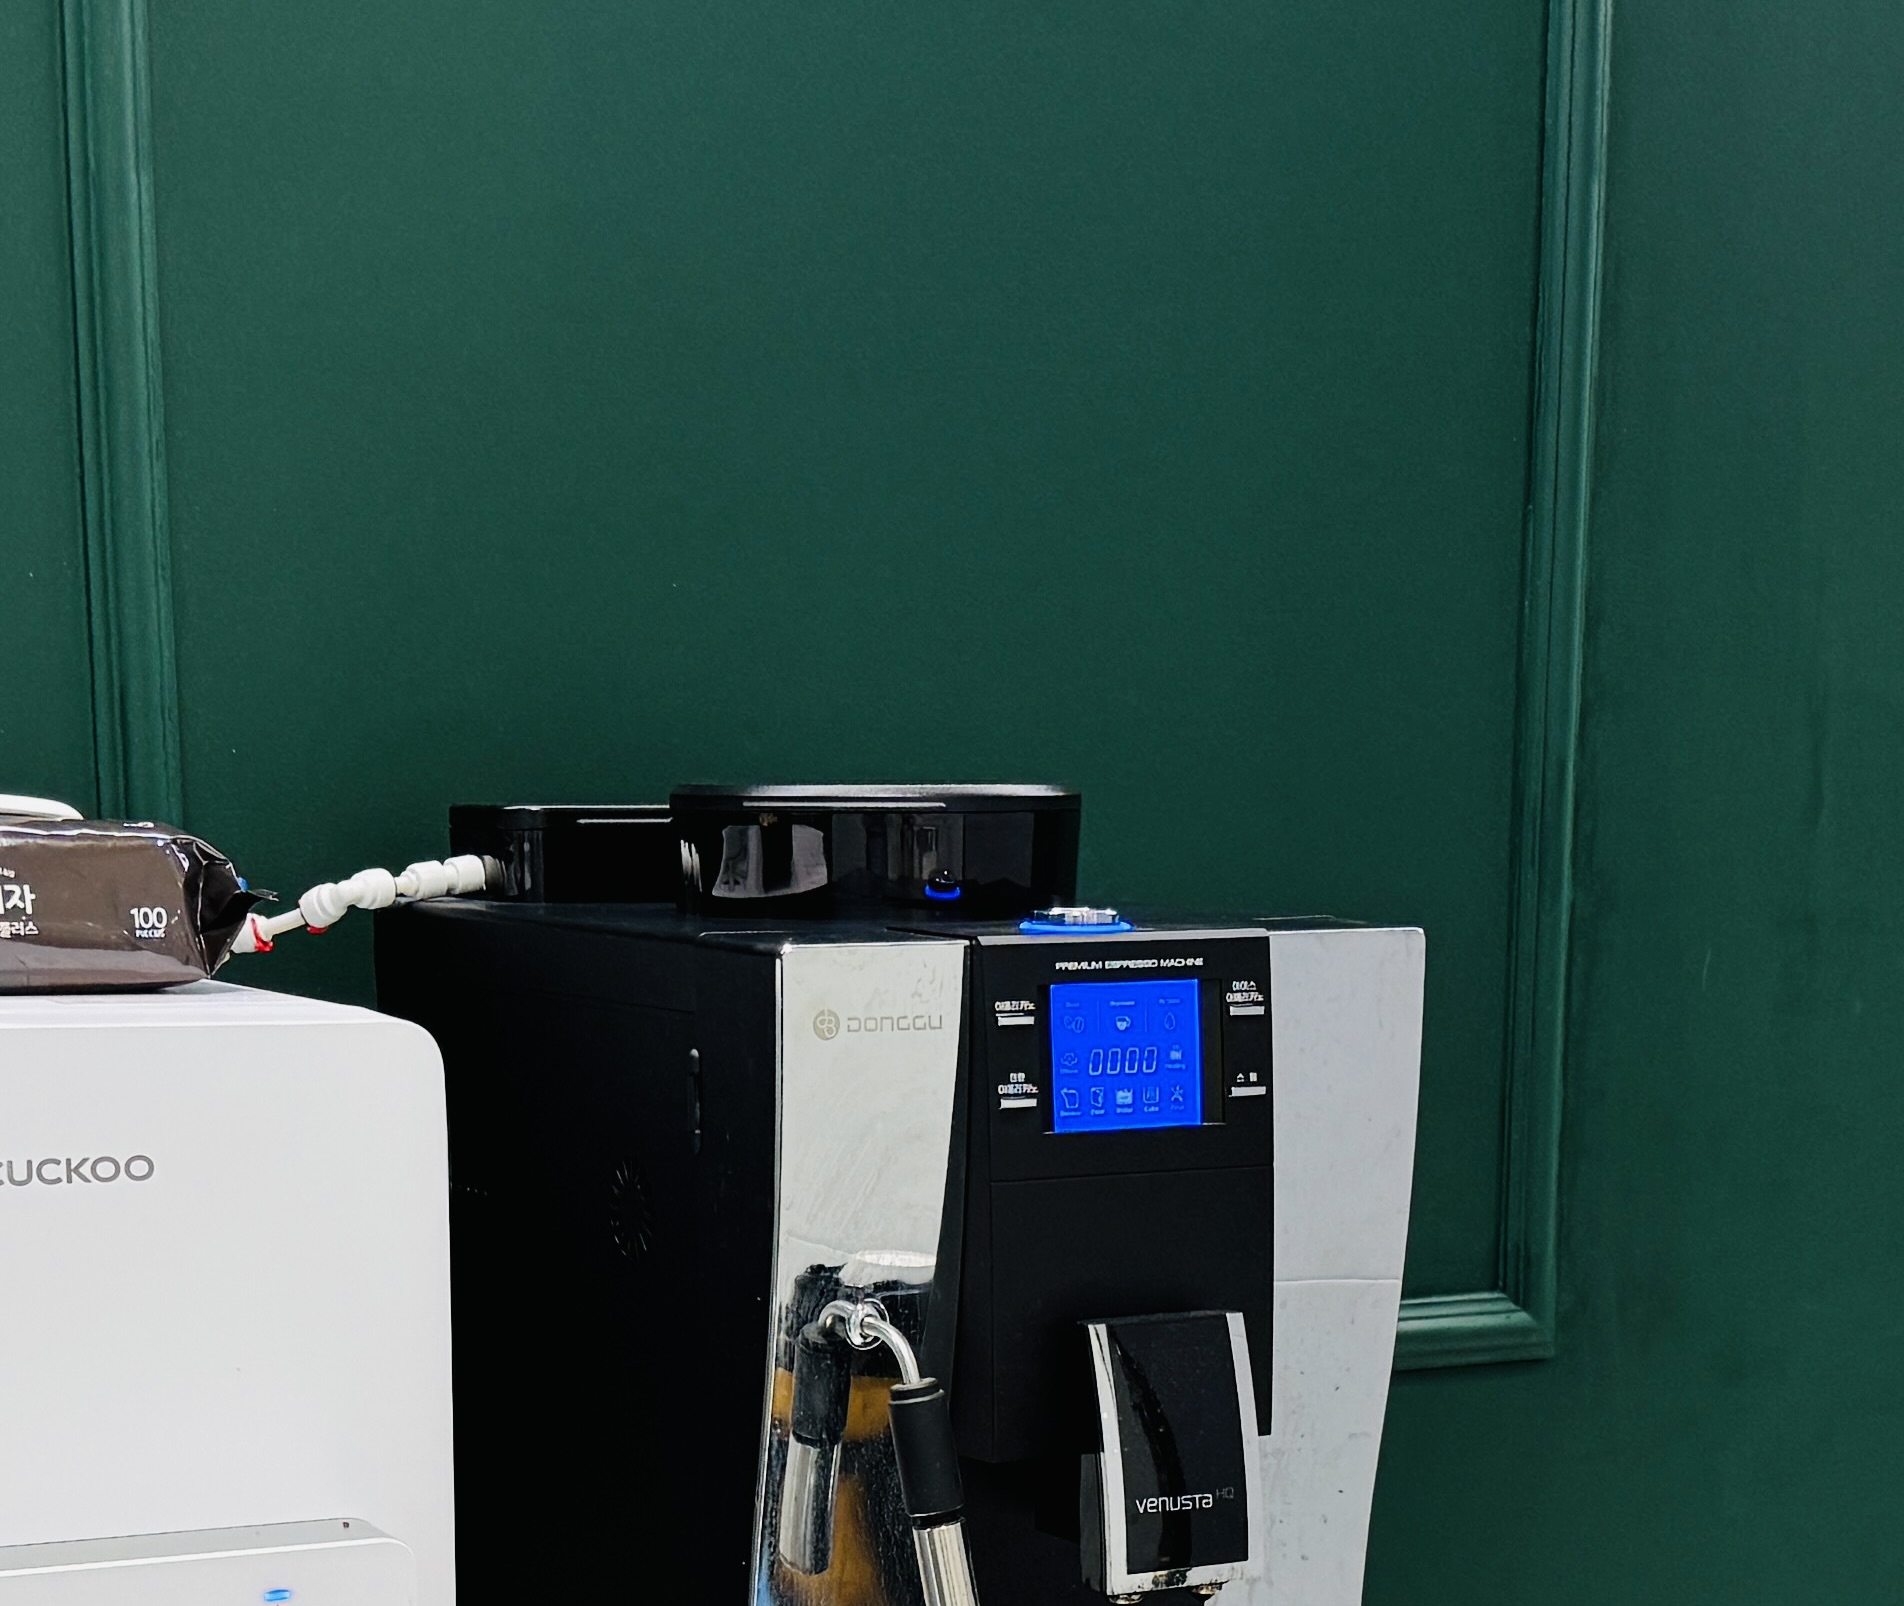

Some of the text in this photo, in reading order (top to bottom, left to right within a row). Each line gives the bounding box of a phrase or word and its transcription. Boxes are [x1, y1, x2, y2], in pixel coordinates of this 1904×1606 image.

[129, 906, 168, 929] 100
[1055, 957, 1204, 971] PREMIUM ESPRESSO MACHINE
[1088, 1046, 1159, 1076] 0000
[1135, 1492, 1214, 1514] venusta
